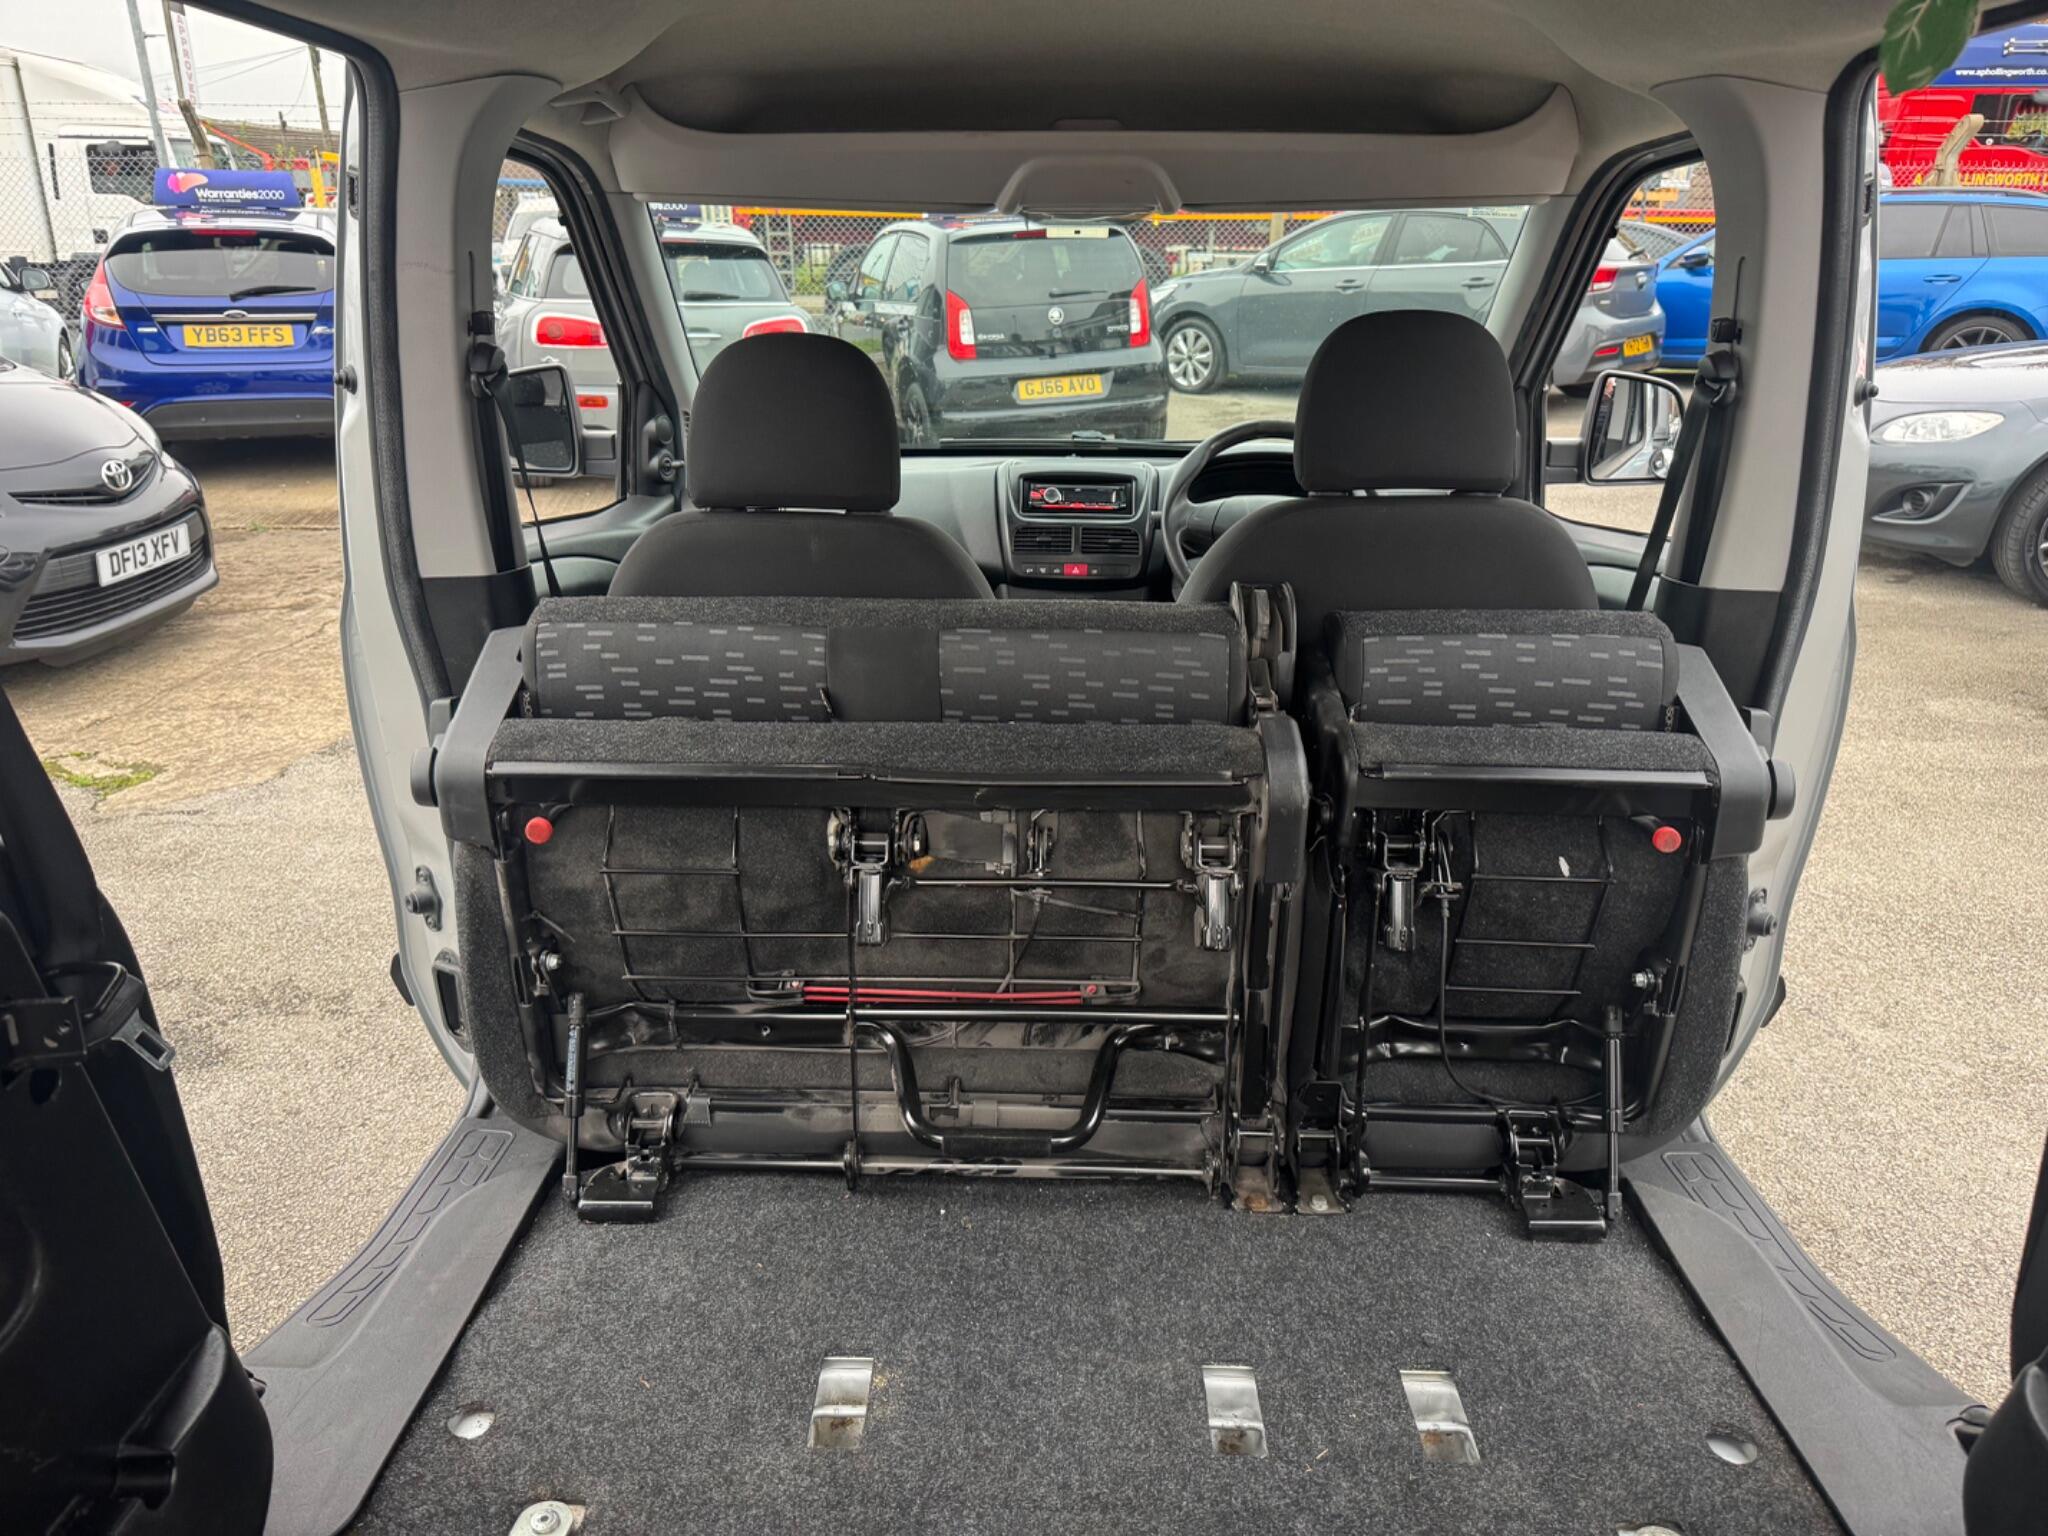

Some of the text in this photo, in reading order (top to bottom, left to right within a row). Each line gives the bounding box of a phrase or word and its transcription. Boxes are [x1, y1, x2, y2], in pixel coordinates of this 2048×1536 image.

[195, 187, 285, 200] Warranties2000
[192, 326, 285, 343] YB63 FFS
[1025, 377, 1095, 396] GJ66 AVO
[109, 528, 179, 577] DF13 XFV
